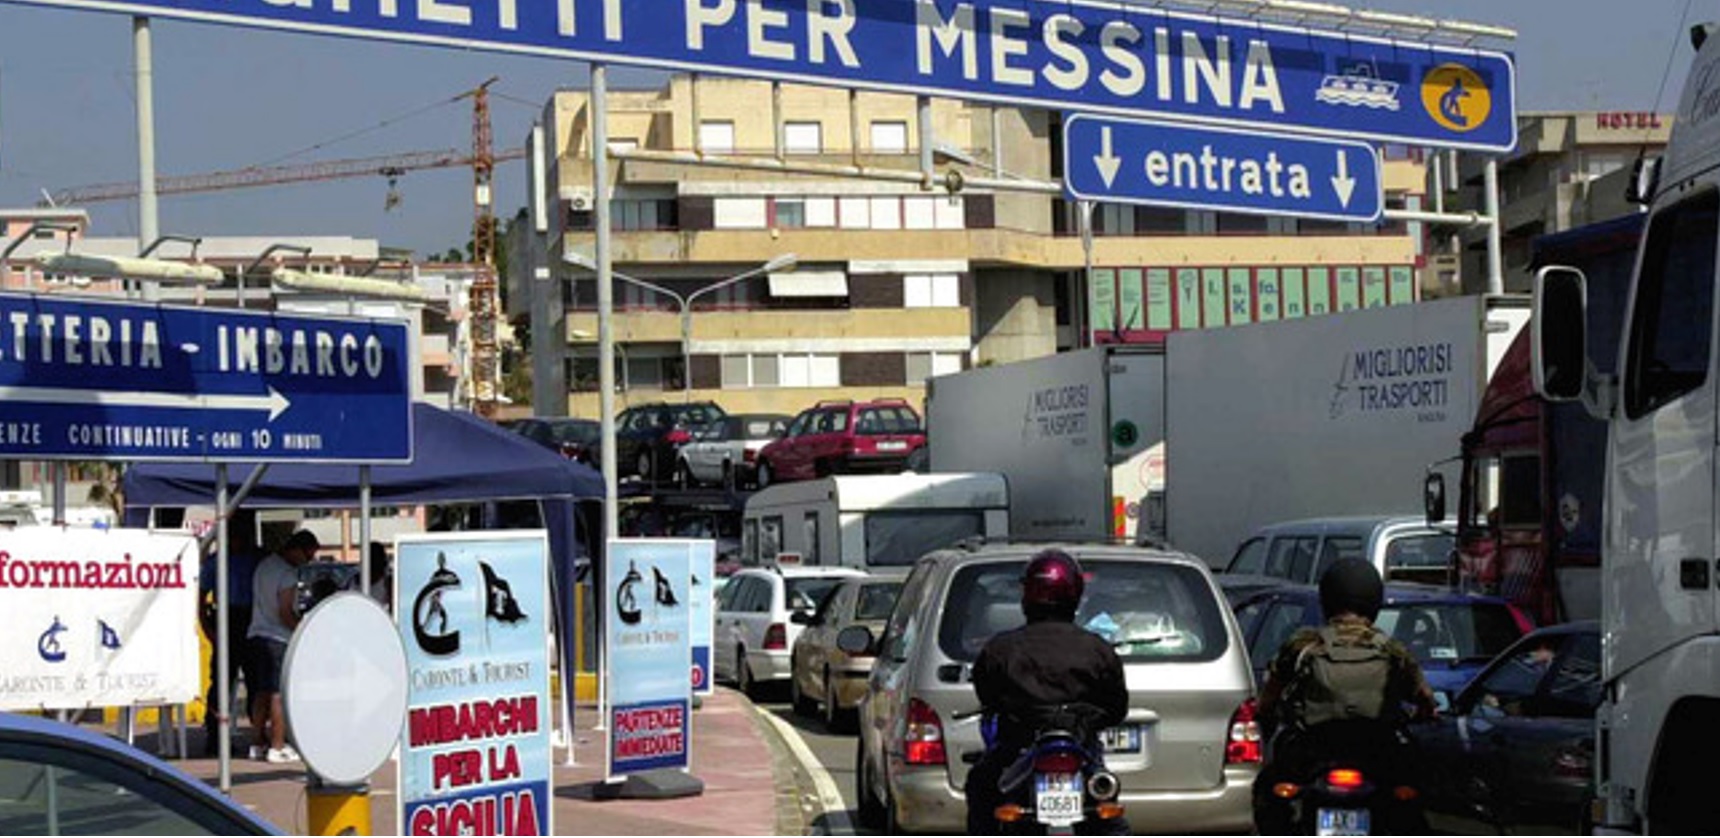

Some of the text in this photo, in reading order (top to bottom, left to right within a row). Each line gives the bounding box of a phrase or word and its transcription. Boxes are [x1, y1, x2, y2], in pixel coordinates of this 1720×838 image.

[686, 0, 861, 68] PER
[915, 0, 1286, 112] MESSINA
[1144, 145, 1312, 198] entrata
[217, 326, 384, 379] IMBARCO
[1353, 343, 1453, 379] MIGLIORISI
[1358, 378, 1448, 411] TRASPORTI
[68, 424, 191, 448] CONTINUATIVE
[212, 433, 244, 448] OGNI
[252, 429, 272, 449] 10
[0, 550, 187, 589] formazioni
[408, 695, 539, 748] IMBARCHI
[432, 743, 521, 790] PER LA
[411, 792, 539, 836] SICILIA
